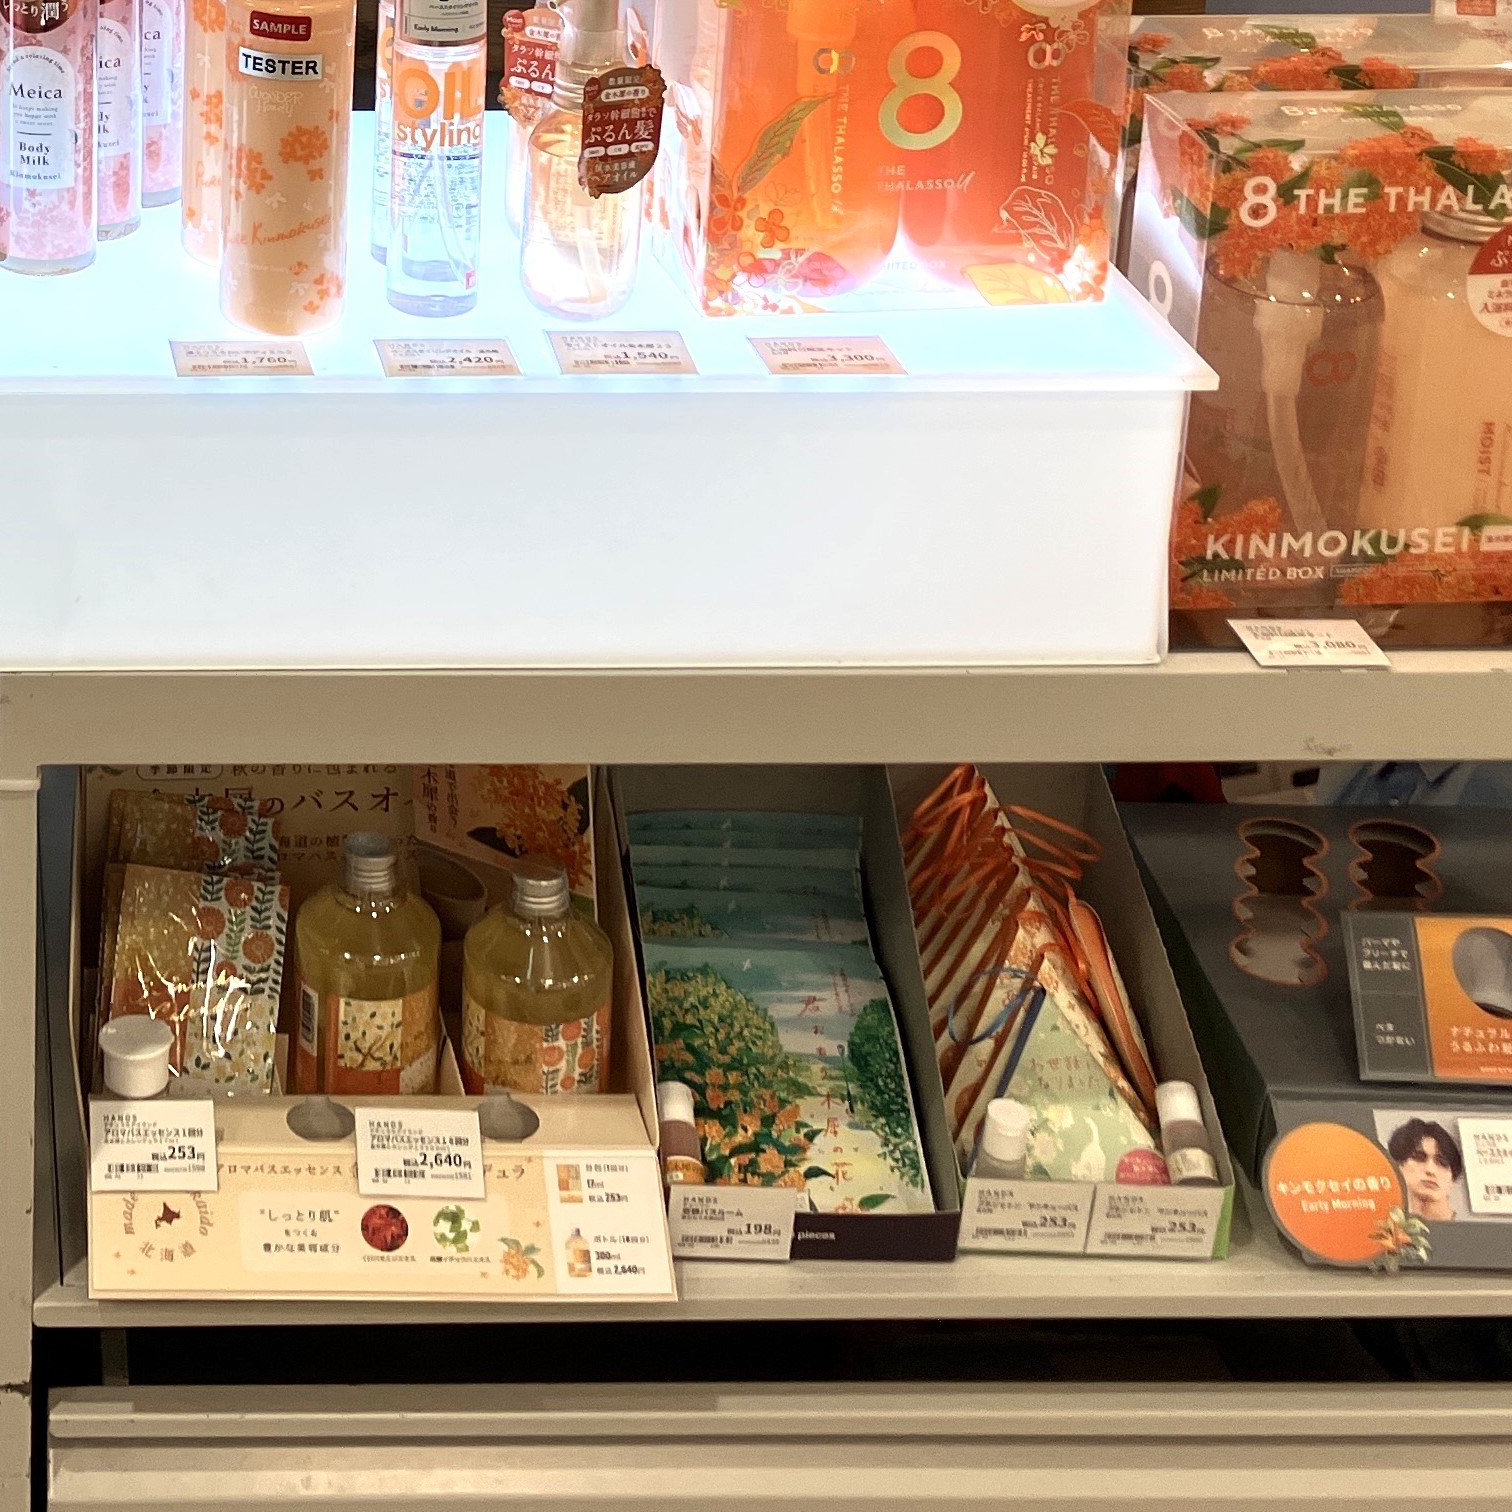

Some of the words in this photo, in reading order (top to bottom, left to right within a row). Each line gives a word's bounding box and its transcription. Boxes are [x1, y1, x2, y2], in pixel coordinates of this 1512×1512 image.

[253, 19, 307, 34] SAMPLE
[242, 54, 319, 75] TESTER
[9, 83, 62, 99] Meica
[395, 63, 483, 120] OIL
[879, 30, 962, 150] 8
[395, 118, 482, 151] styling
[585, 121, 654, 143] ぷるん髪
[19, 142, 51, 156] Body
[832, 118, 848, 194] THALASSO
[20, 155, 49, 166] Milk
[1239, 176, 1279, 228] 8
[1293, 187, 1368, 215] THE
[1384, 183, 1512, 214] THALA
[1206, 526, 1469, 560] KINMOKUSEI
[1202, 566, 1282, 582] LIMITED
[1286, 565, 1326, 580] BOX
[103, 1114, 137, 1122] HANDS
[368, 1120, 403, 1129] HANDS
[152, 1146, 205, 1161] 税込253円
[403, 1152, 472, 1170] 税込2,640円
[1276, 1175, 1392, 1195] キンモクセイの香り
[122, 1192, 138, 1235] made
[1301, 1198, 1325, 1211] Early
[1328, 1197, 1375, 1211] Morning
